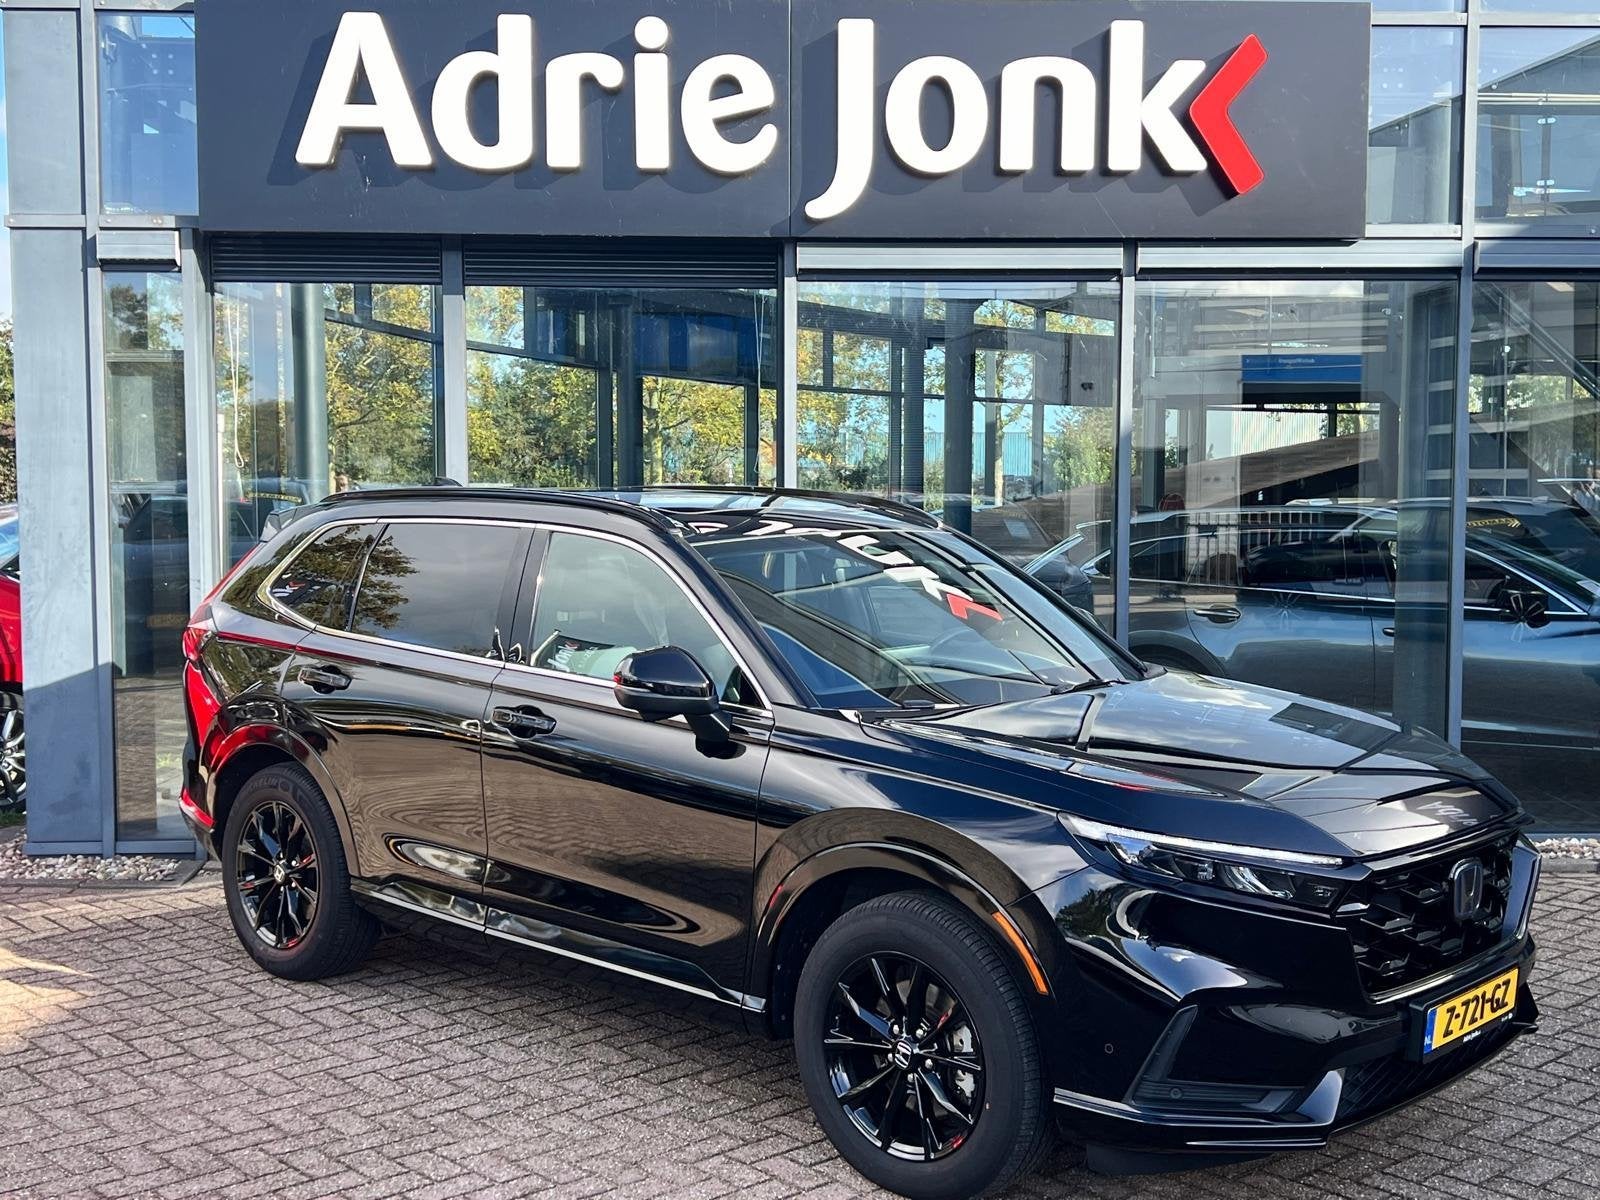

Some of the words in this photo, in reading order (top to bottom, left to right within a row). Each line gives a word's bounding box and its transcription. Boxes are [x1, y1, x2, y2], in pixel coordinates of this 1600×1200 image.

[296, 11, 778, 175] Adrie
[804, 17, 1207, 220] Jonk
[1442, 978, 1511, 1039] Z-721-GZ
